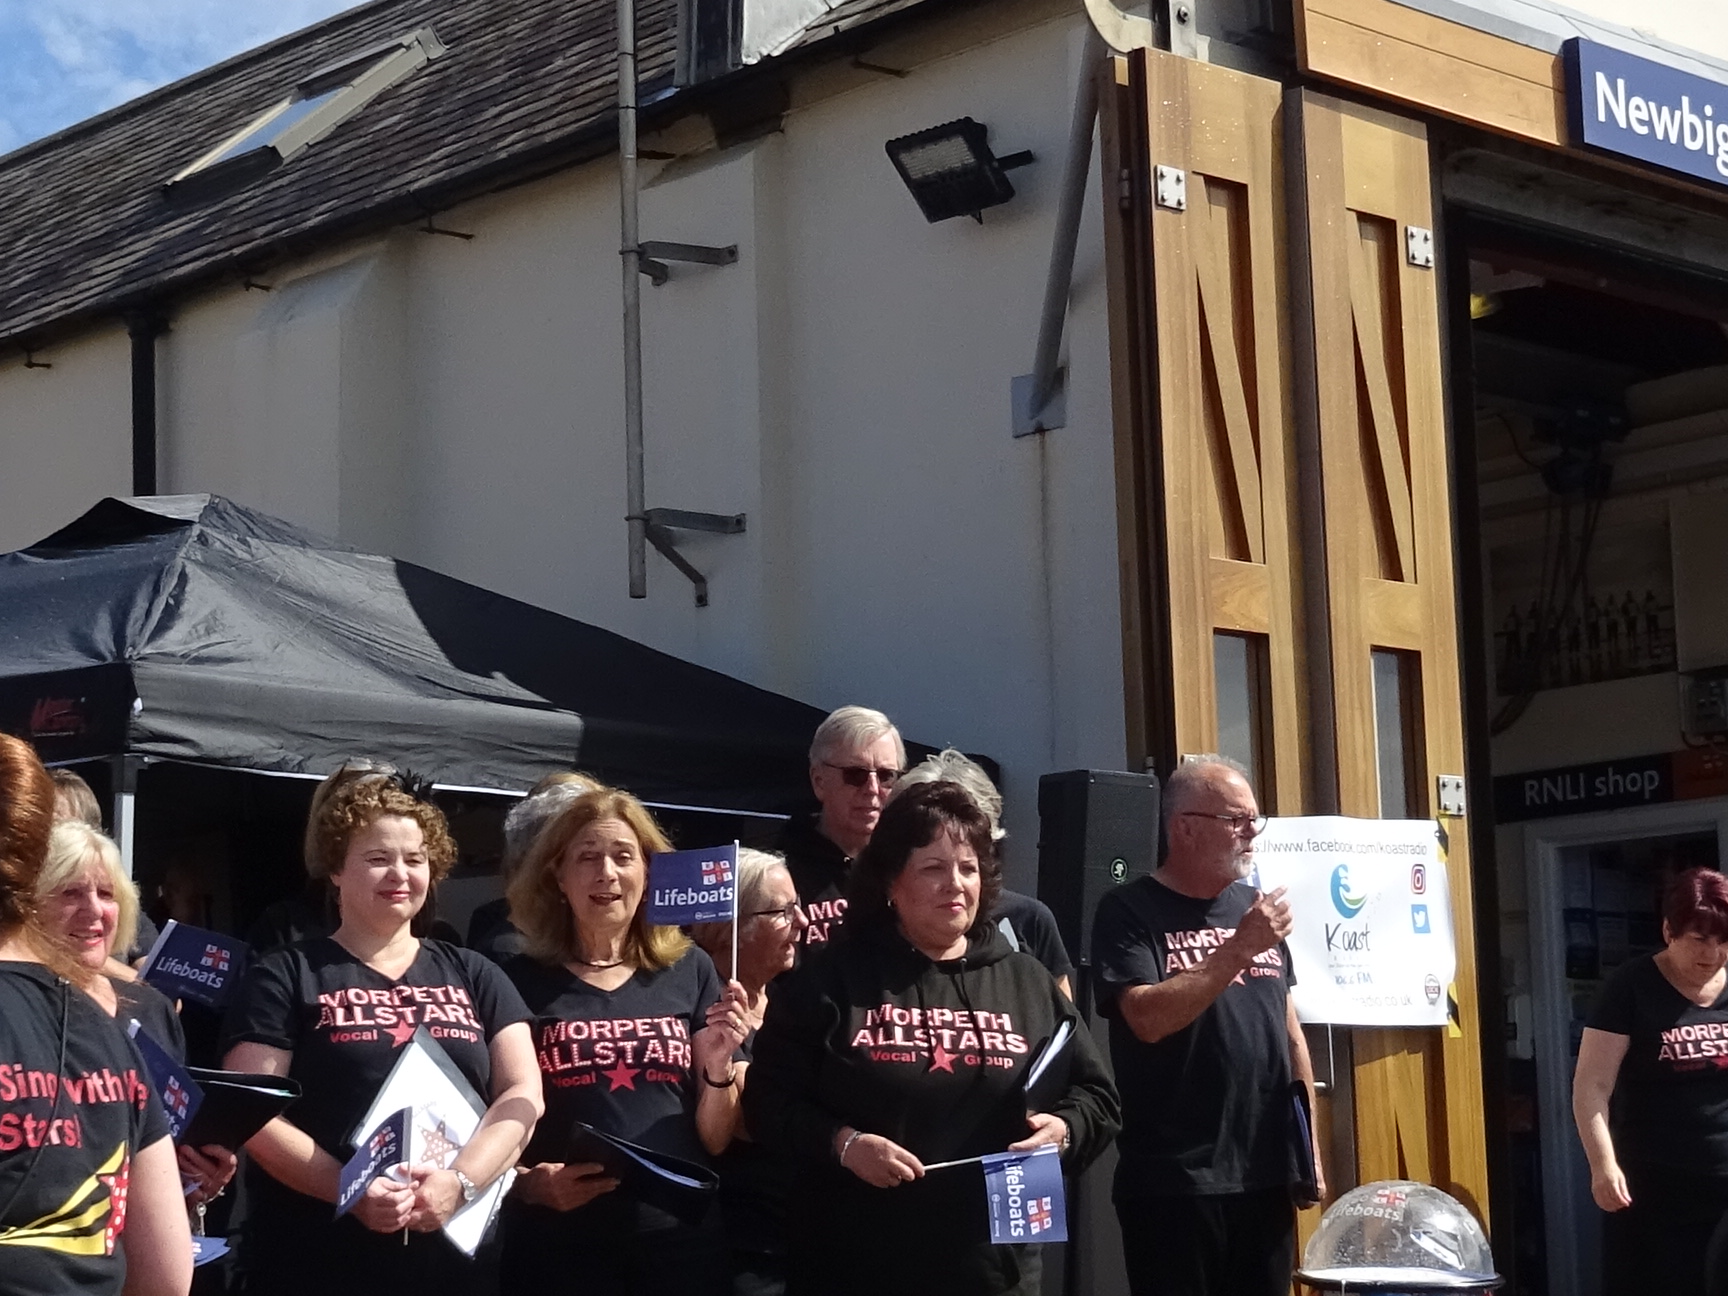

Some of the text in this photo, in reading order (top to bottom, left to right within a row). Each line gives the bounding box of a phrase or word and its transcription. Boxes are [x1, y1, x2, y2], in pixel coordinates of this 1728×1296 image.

[1524, 766, 1660, 806] RNLI shop
[654, 886, 734, 906] Lifeboats
[1324, 922, 1371, 952] Koast
[155, 956, 225, 989] Lifeboats
[317, 984, 470, 1008] MORPETH
[314, 1003, 482, 1030] ALLSTARS
[866, 1003, 1013, 1032] MORPETH
[330, 1025, 479, 1043] Vocal Group
[542, 1016, 688, 1047] MORPETH
[851, 1026, 1029, 1054] ALLSTARS
[539, 1038, 692, 1073] ALLSTARS
[870, 1050, 917, 1064] Vocal
